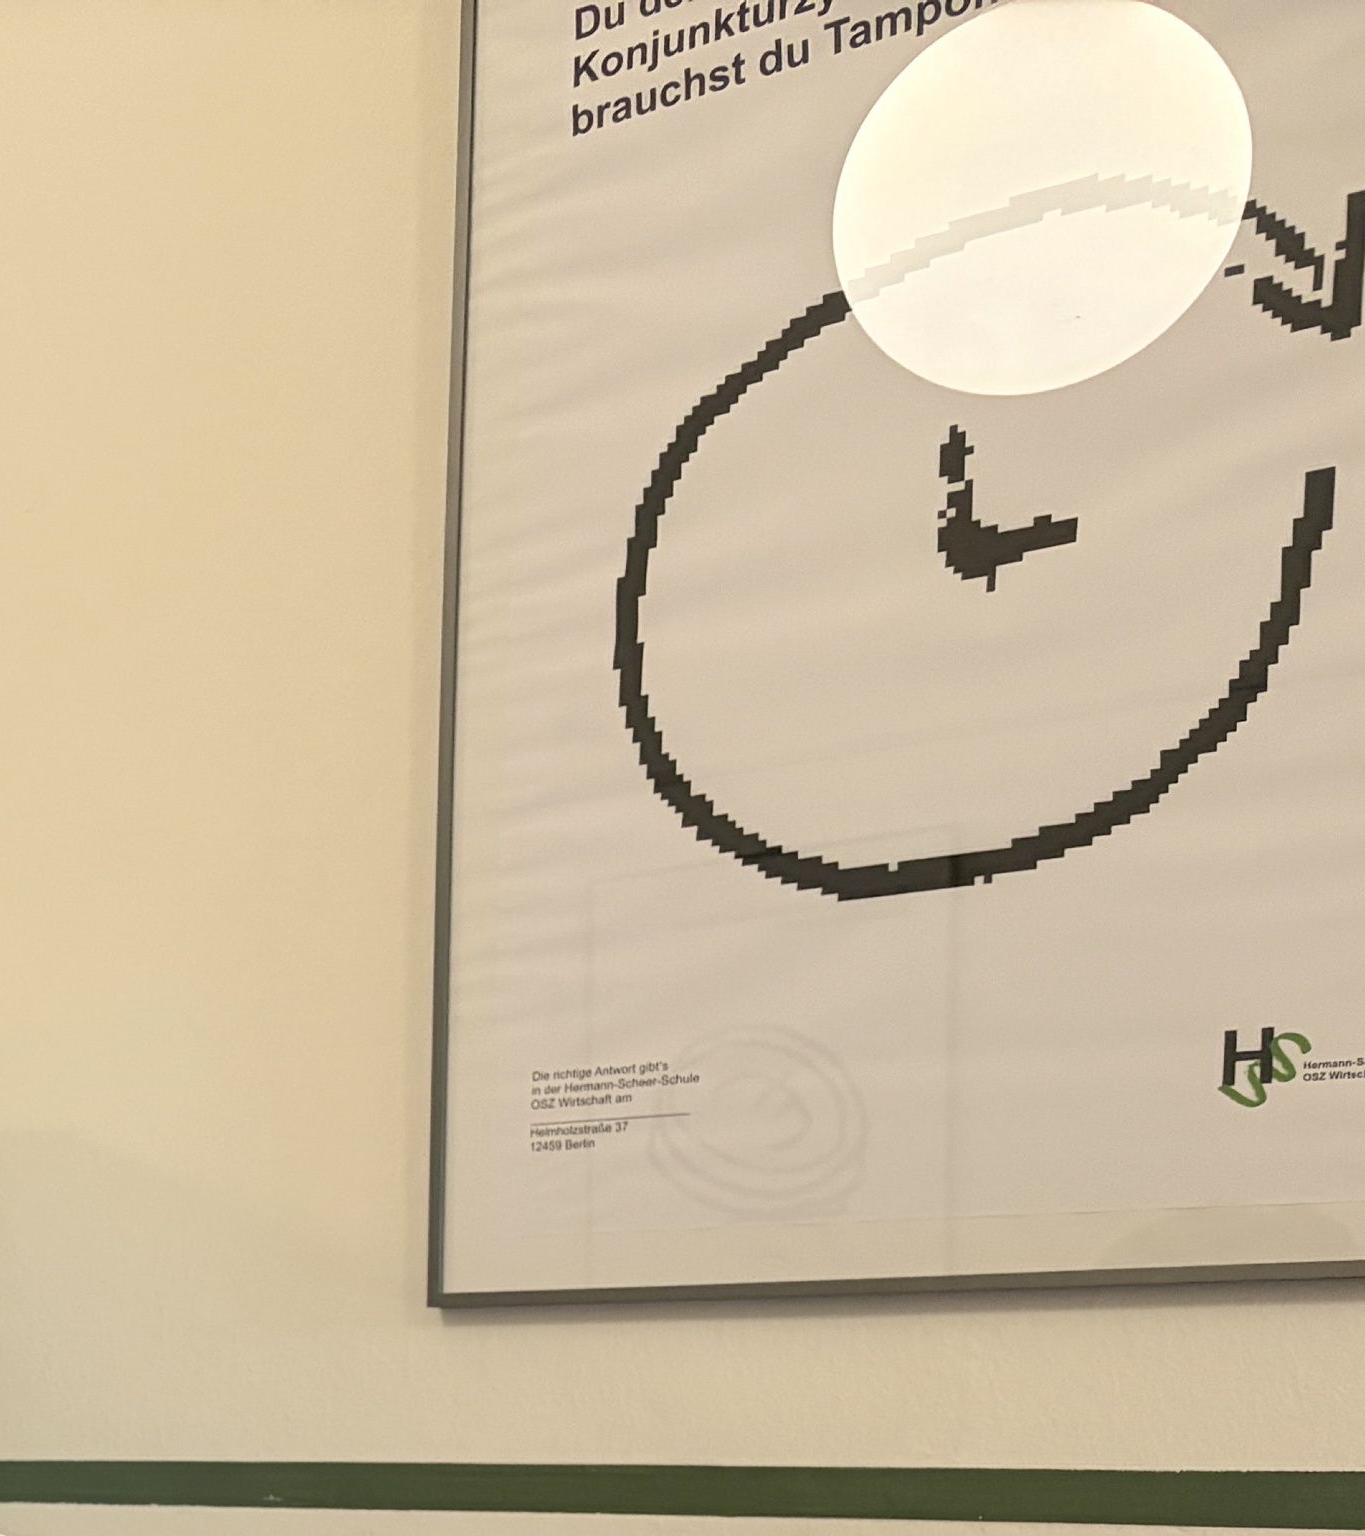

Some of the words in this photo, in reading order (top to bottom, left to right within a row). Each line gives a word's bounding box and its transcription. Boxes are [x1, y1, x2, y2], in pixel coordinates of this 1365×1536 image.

[575, 0, 625, 41] Du
[572, 53, 746, 137] brauchst
[759, 38, 809, 76] du
[532, 1070, 550, 1082] Die
[553, 1068, 592, 1081] richtige
[594, 1064, 636, 1077] Antwort
[639, 1061, 669, 1076] gibt's
[1303, 1071, 1327, 1082] OSZ
[1329, 1069, 1365, 1080] Wirtsc
[531, 1085, 541, 1096] in
[544, 1084, 561, 1095] der
[564, 1072, 700, 1093] Hermann-Scheer-Schule
[531, 1097, 556, 1110] OSZ
[558, 1093, 613, 1108] Wirtschaft
[615, 1094, 633, 1103] am
[615, 1120, 629, 1132] 37
[531, 1139, 562, 1152] 12459
[565, 1138, 596, 1150] Berlin
